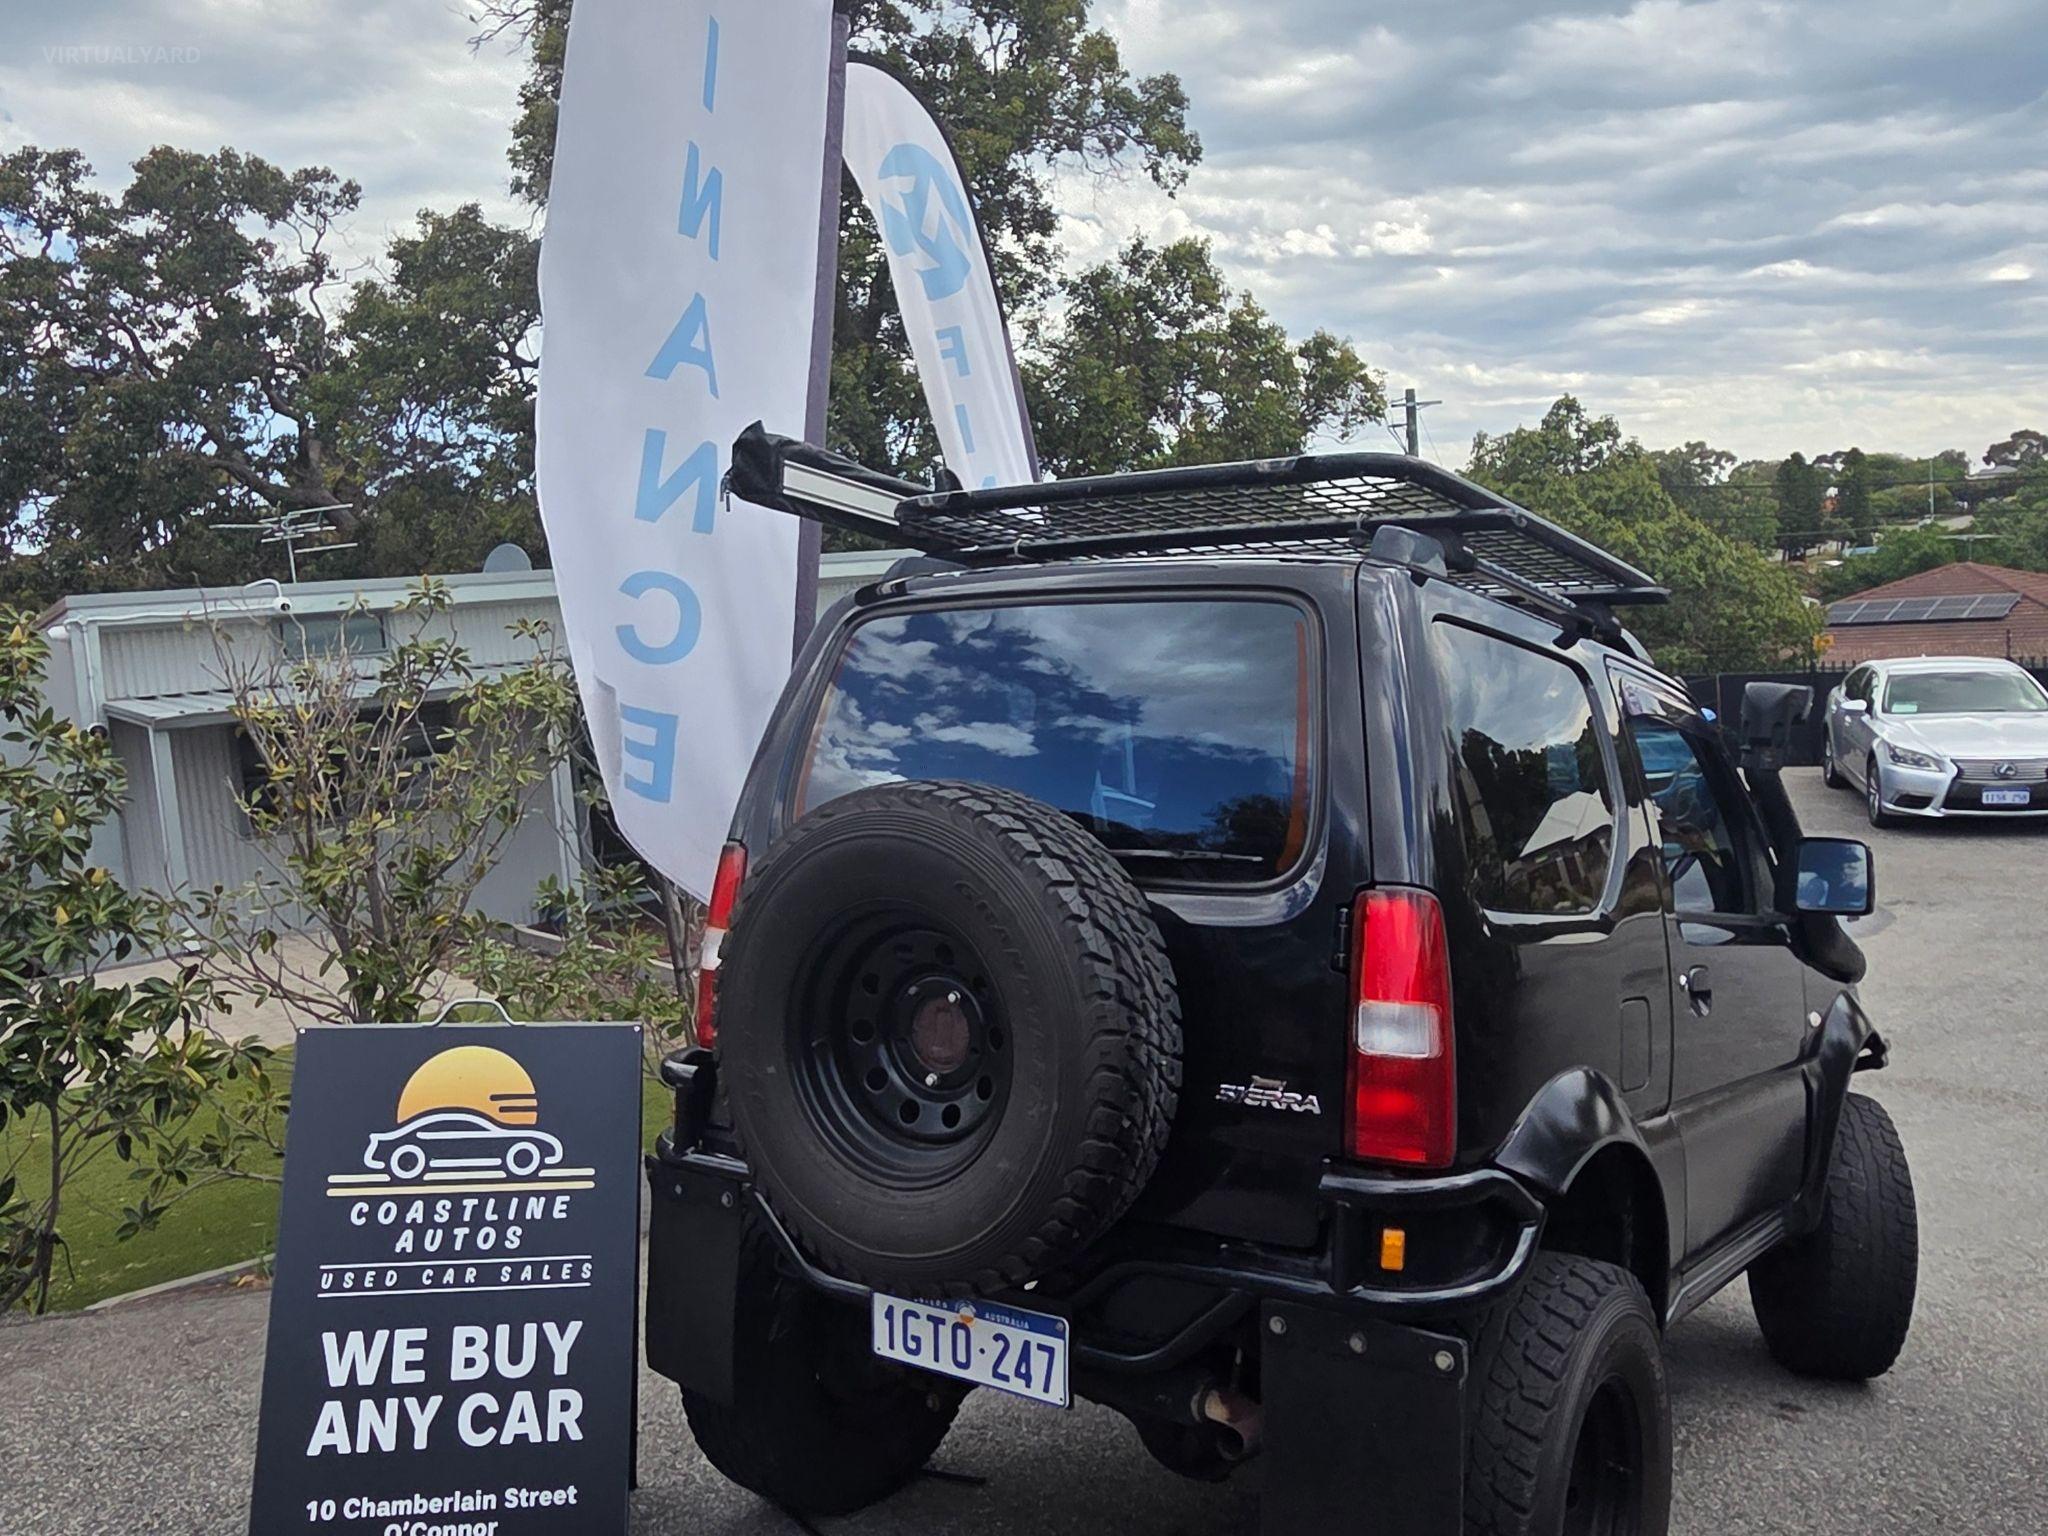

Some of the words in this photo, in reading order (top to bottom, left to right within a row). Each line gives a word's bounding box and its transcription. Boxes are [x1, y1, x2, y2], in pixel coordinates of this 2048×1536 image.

[350, 1195, 571, 1226] COASTLINE
[394, 1226, 523, 1253] AUTOS
[321, 1270, 398, 1290] USED
[422, 1267, 477, 1286] CAR
[500, 1262, 593, 1283] SALES
[321, 1327, 428, 1388] WE
[450, 1320, 583, 1381] BUY
[306, 1395, 444, 1457] ANY
[457, 1388, 584, 1447] CAR
[306, 1499, 336, 1522] 10
[343, 1489, 497, 1520] Chamberlain
[504, 1485, 578, 1509] Street
